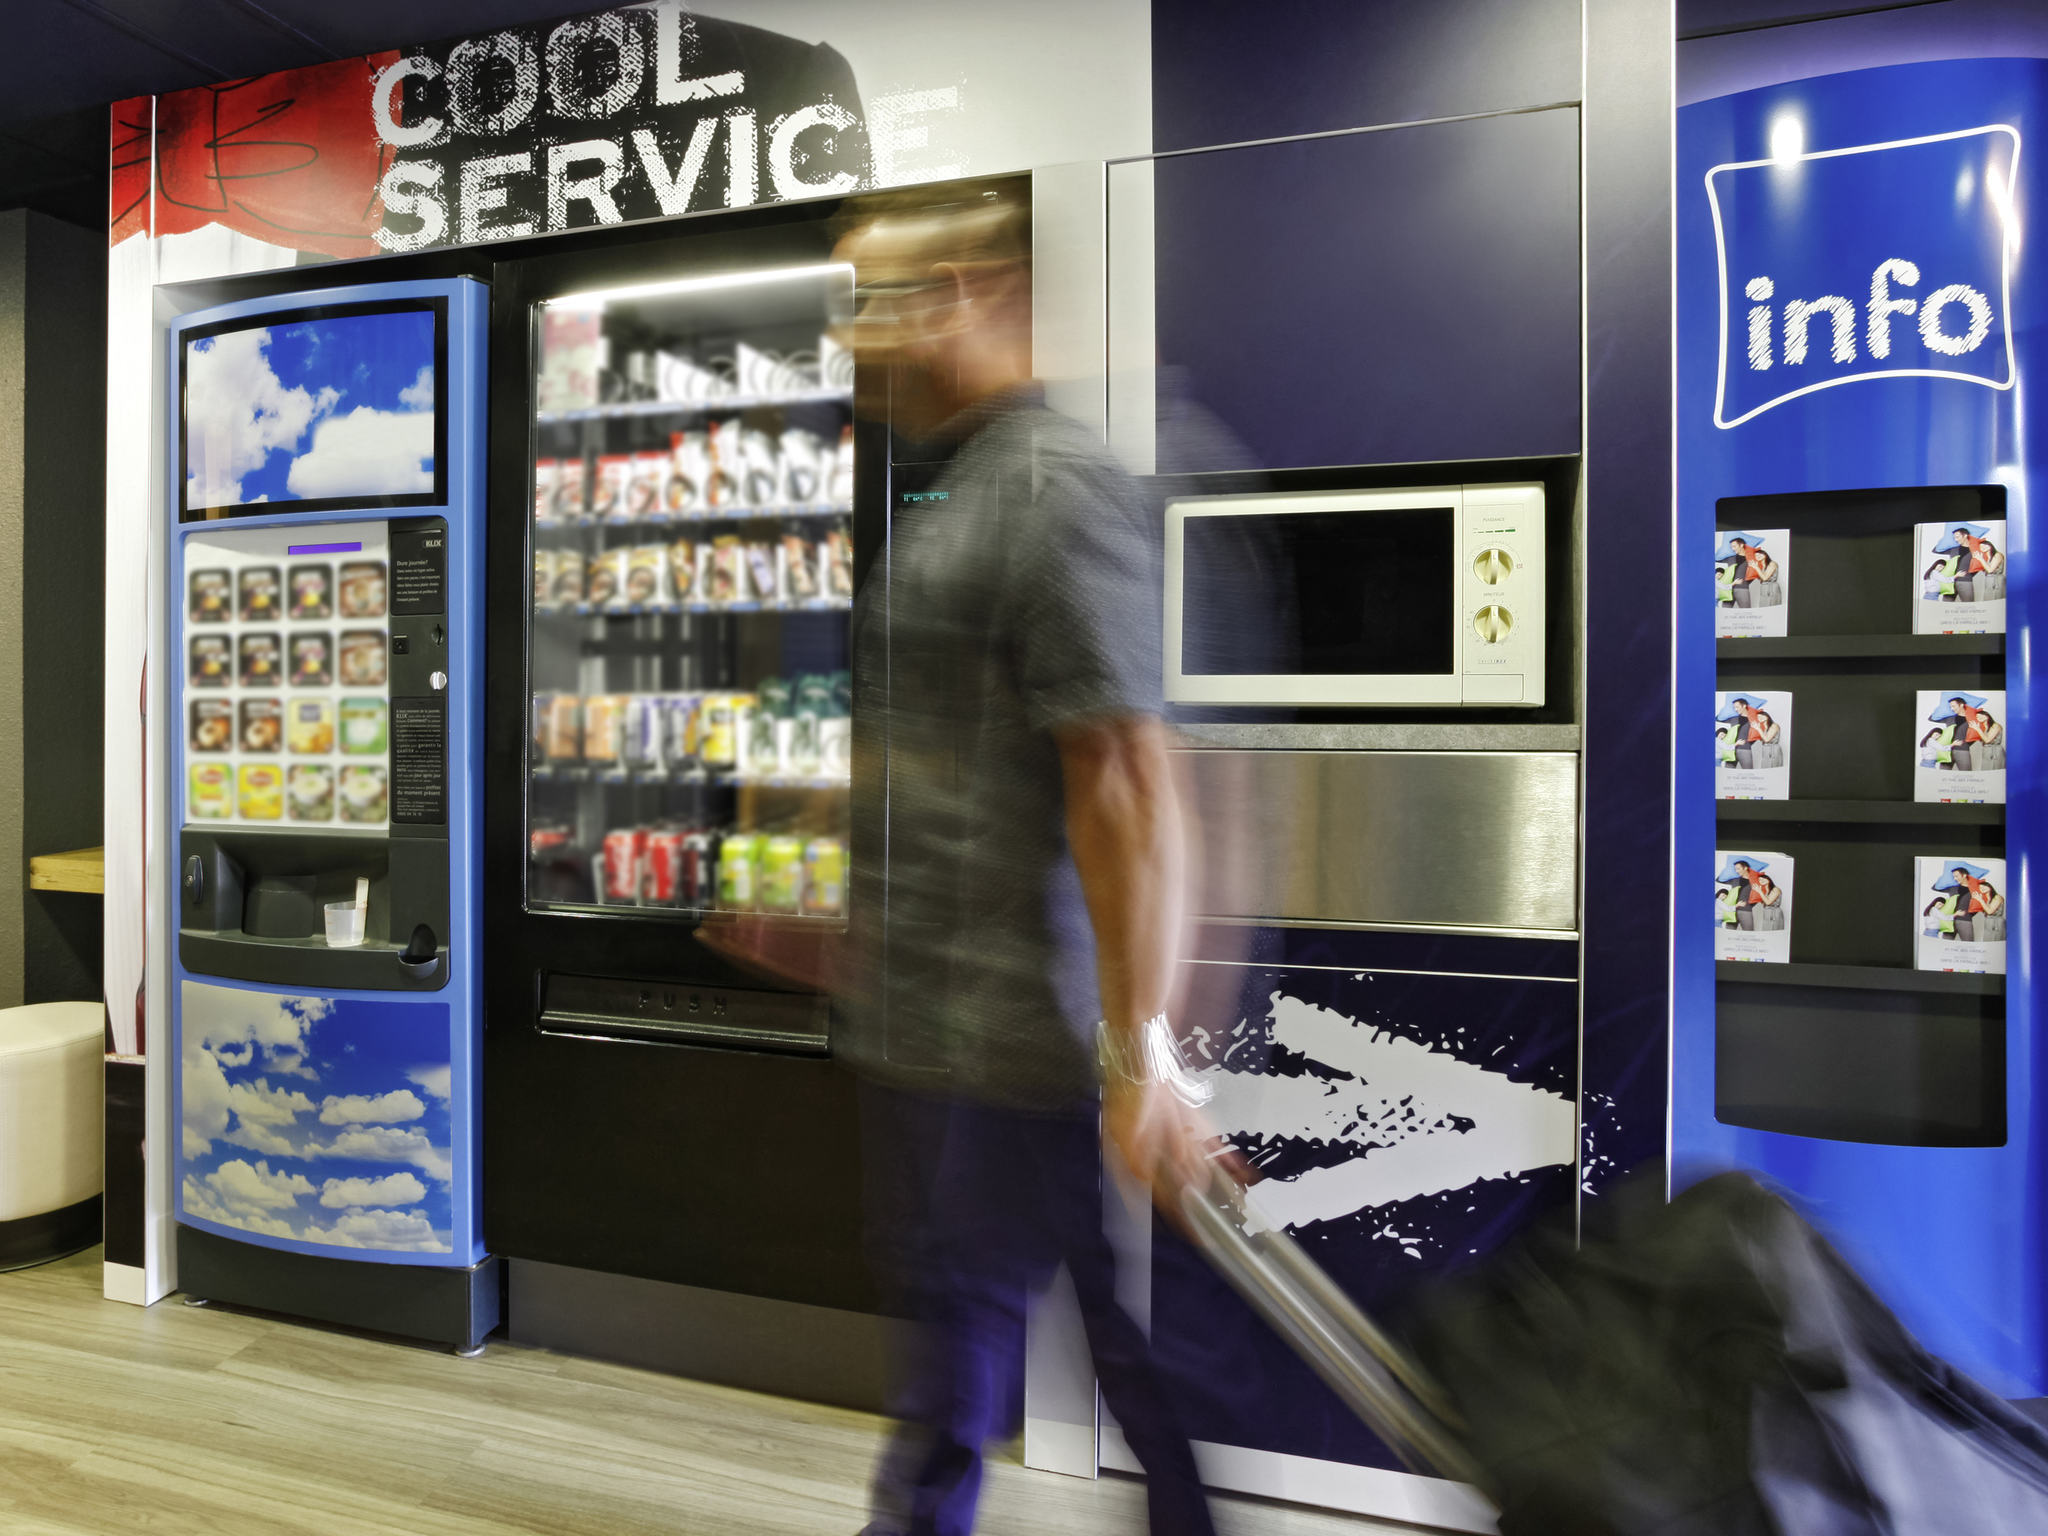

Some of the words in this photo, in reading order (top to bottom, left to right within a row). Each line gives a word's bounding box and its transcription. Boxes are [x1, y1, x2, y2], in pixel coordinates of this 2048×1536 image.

[371, 0, 745, 149] COOL
[371, 84, 967, 254] SERVICE
[1745, 257, 1995, 371] info
[637, 990, 729, 1016] PUSH
